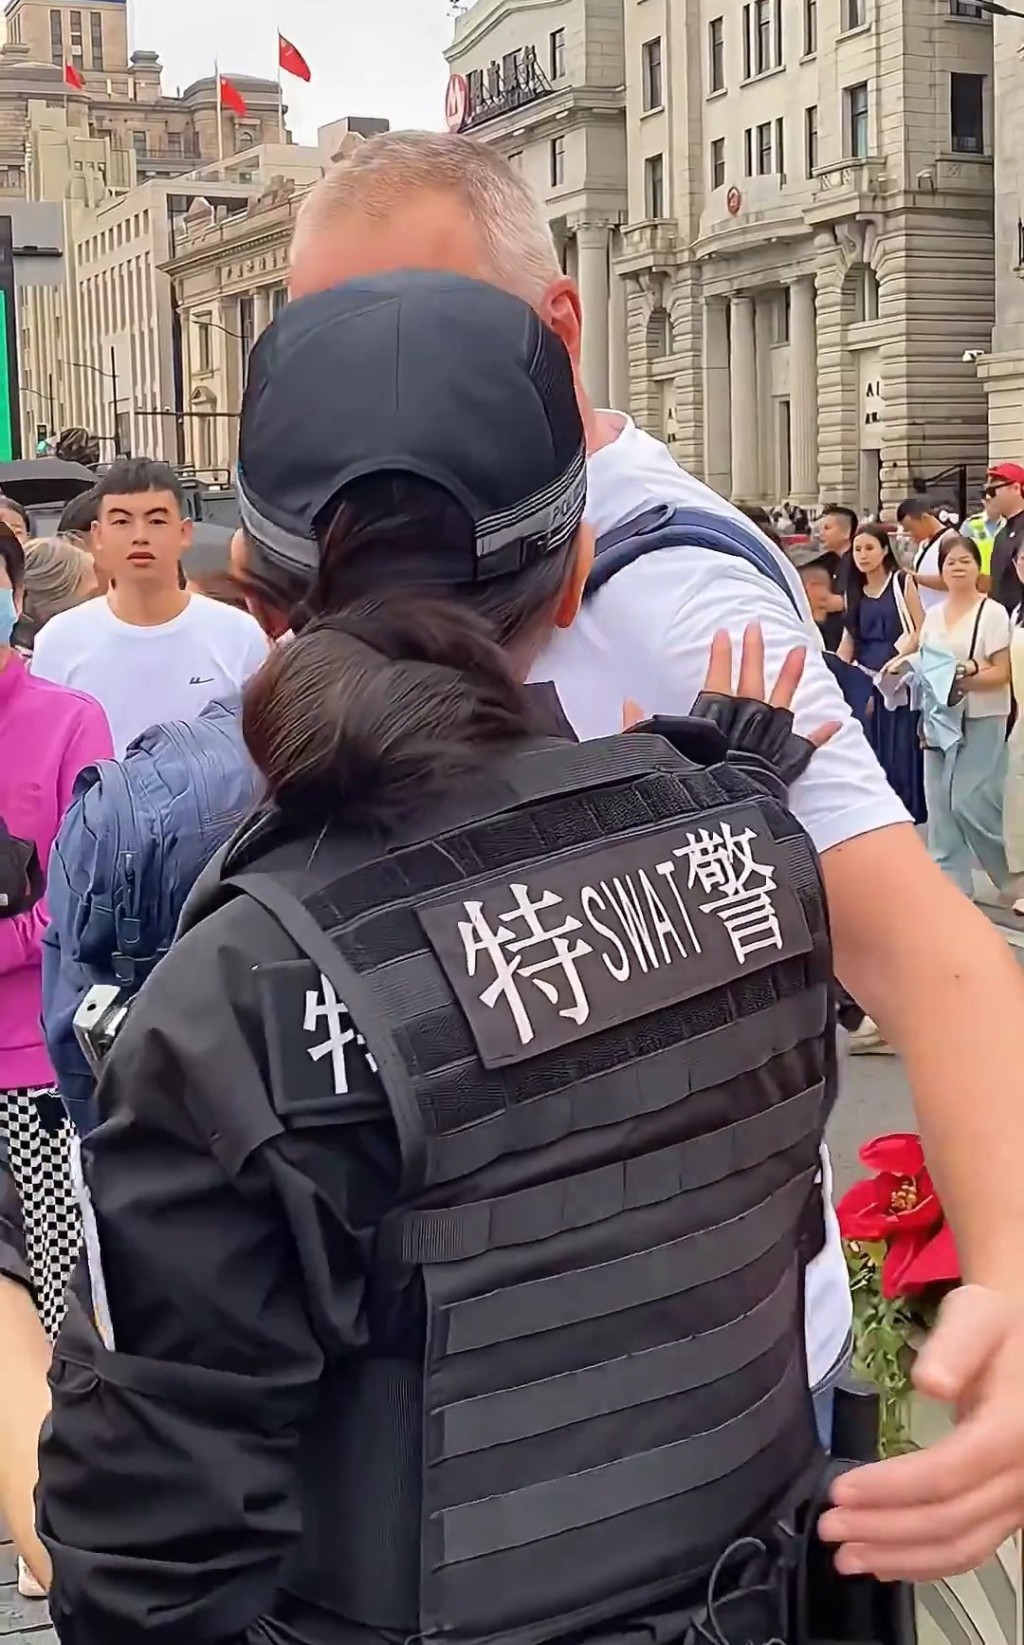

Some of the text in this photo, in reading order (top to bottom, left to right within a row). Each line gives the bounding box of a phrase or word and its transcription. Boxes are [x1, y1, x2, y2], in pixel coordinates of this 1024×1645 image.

[457, 883, 594, 1044] 特
[580, 859, 702, 982] SWAT
[673, 821, 783, 965] 警
